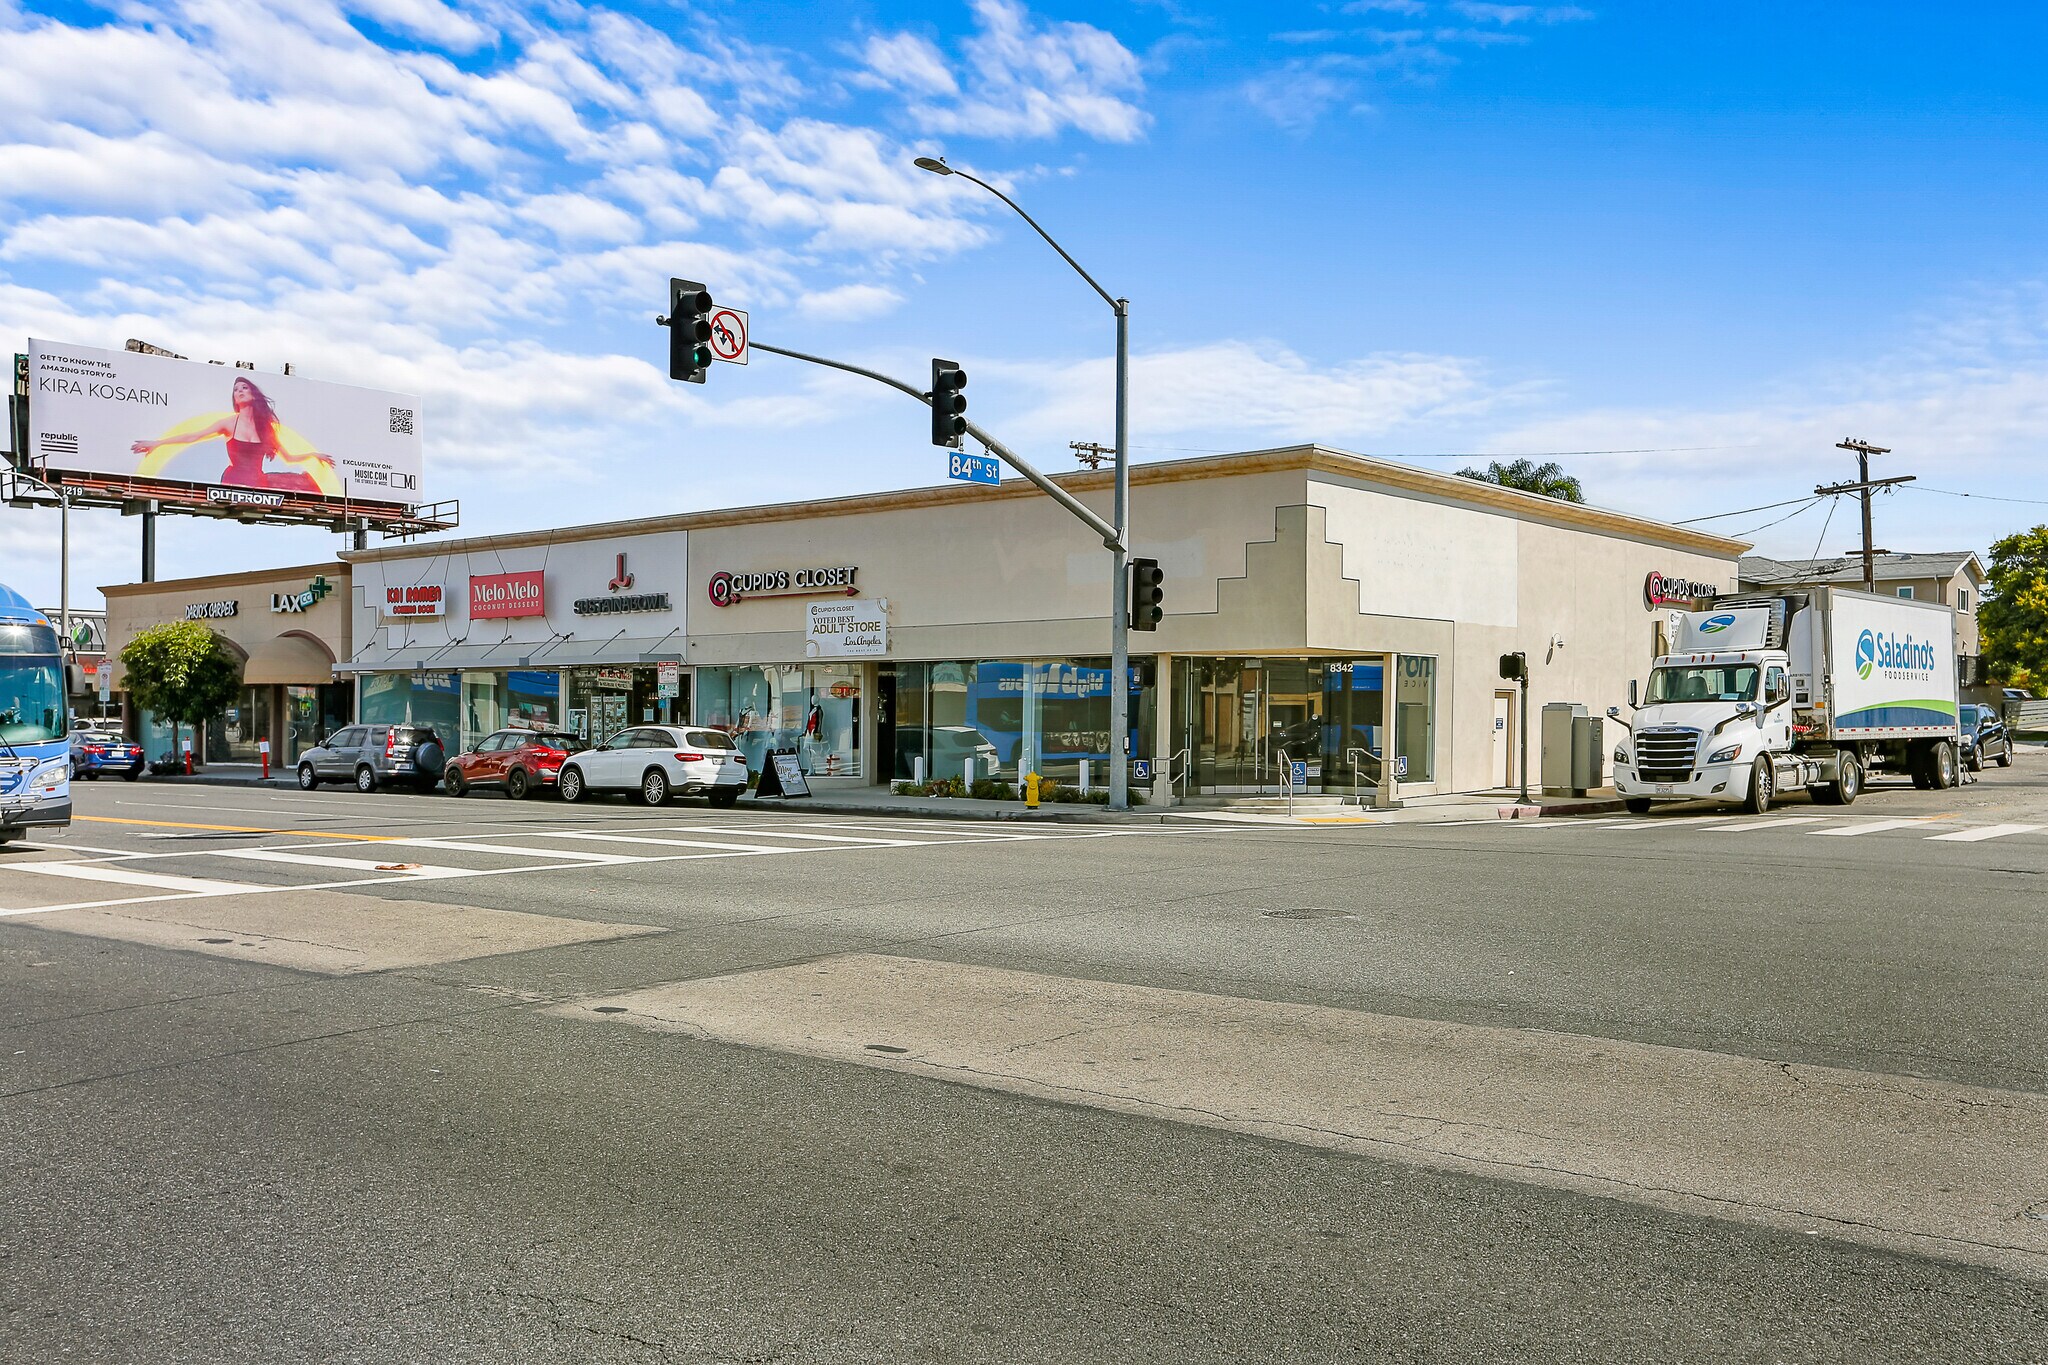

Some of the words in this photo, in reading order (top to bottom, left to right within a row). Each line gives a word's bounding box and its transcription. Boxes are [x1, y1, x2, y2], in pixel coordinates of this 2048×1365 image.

[40, 353, 56, 361] GET
[70, 358, 96, 367] KNOW
[96, 361, 111, 369] THE
[40, 364, 79, 374] AMAZING
[80, 369, 105, 378] STORY
[39, 377, 83, 395] KIRA
[89, 383, 168, 406] KOSARIN
[40, 432, 78, 441] republic
[342, 459, 381, 469] EXCLUSIVELY
[951, 455, 982, 478] 84th
[985, 463, 998, 479] St
[354, 469, 388, 481] MUSIC.COM
[61, 486, 83, 496] 1219
[731, 571, 788, 592] CUPID'S
[794, 567, 858, 588] CLOSET
[1661, 577, 1690, 596] CUPID'S
[405, 585, 442, 603] RAMEN
[474, 583, 505, 603] Melo
[506, 580, 539, 601] Melo
[270, 593, 302, 613] LAX
[301, 592, 312, 604] CC
[474, 603, 505, 611] COCONUT
[508, 601, 539, 609] DESSERT
[573, 593, 672, 616] SUSTAINABOWL
[813, 616, 837, 625] VOTED
[837, 615, 855, 624] BEST
[812, 623, 846, 635] ADULT
[847, 621, 881, 633] STORE
[843, 636, 857, 647] Los
[857, 635, 882, 647] Angeles
[1876, 631, 1935, 671] Saladino's
[1329, 663, 1354, 673] 8342
[1884, 670, 1929, 682] FOODSERVICE
